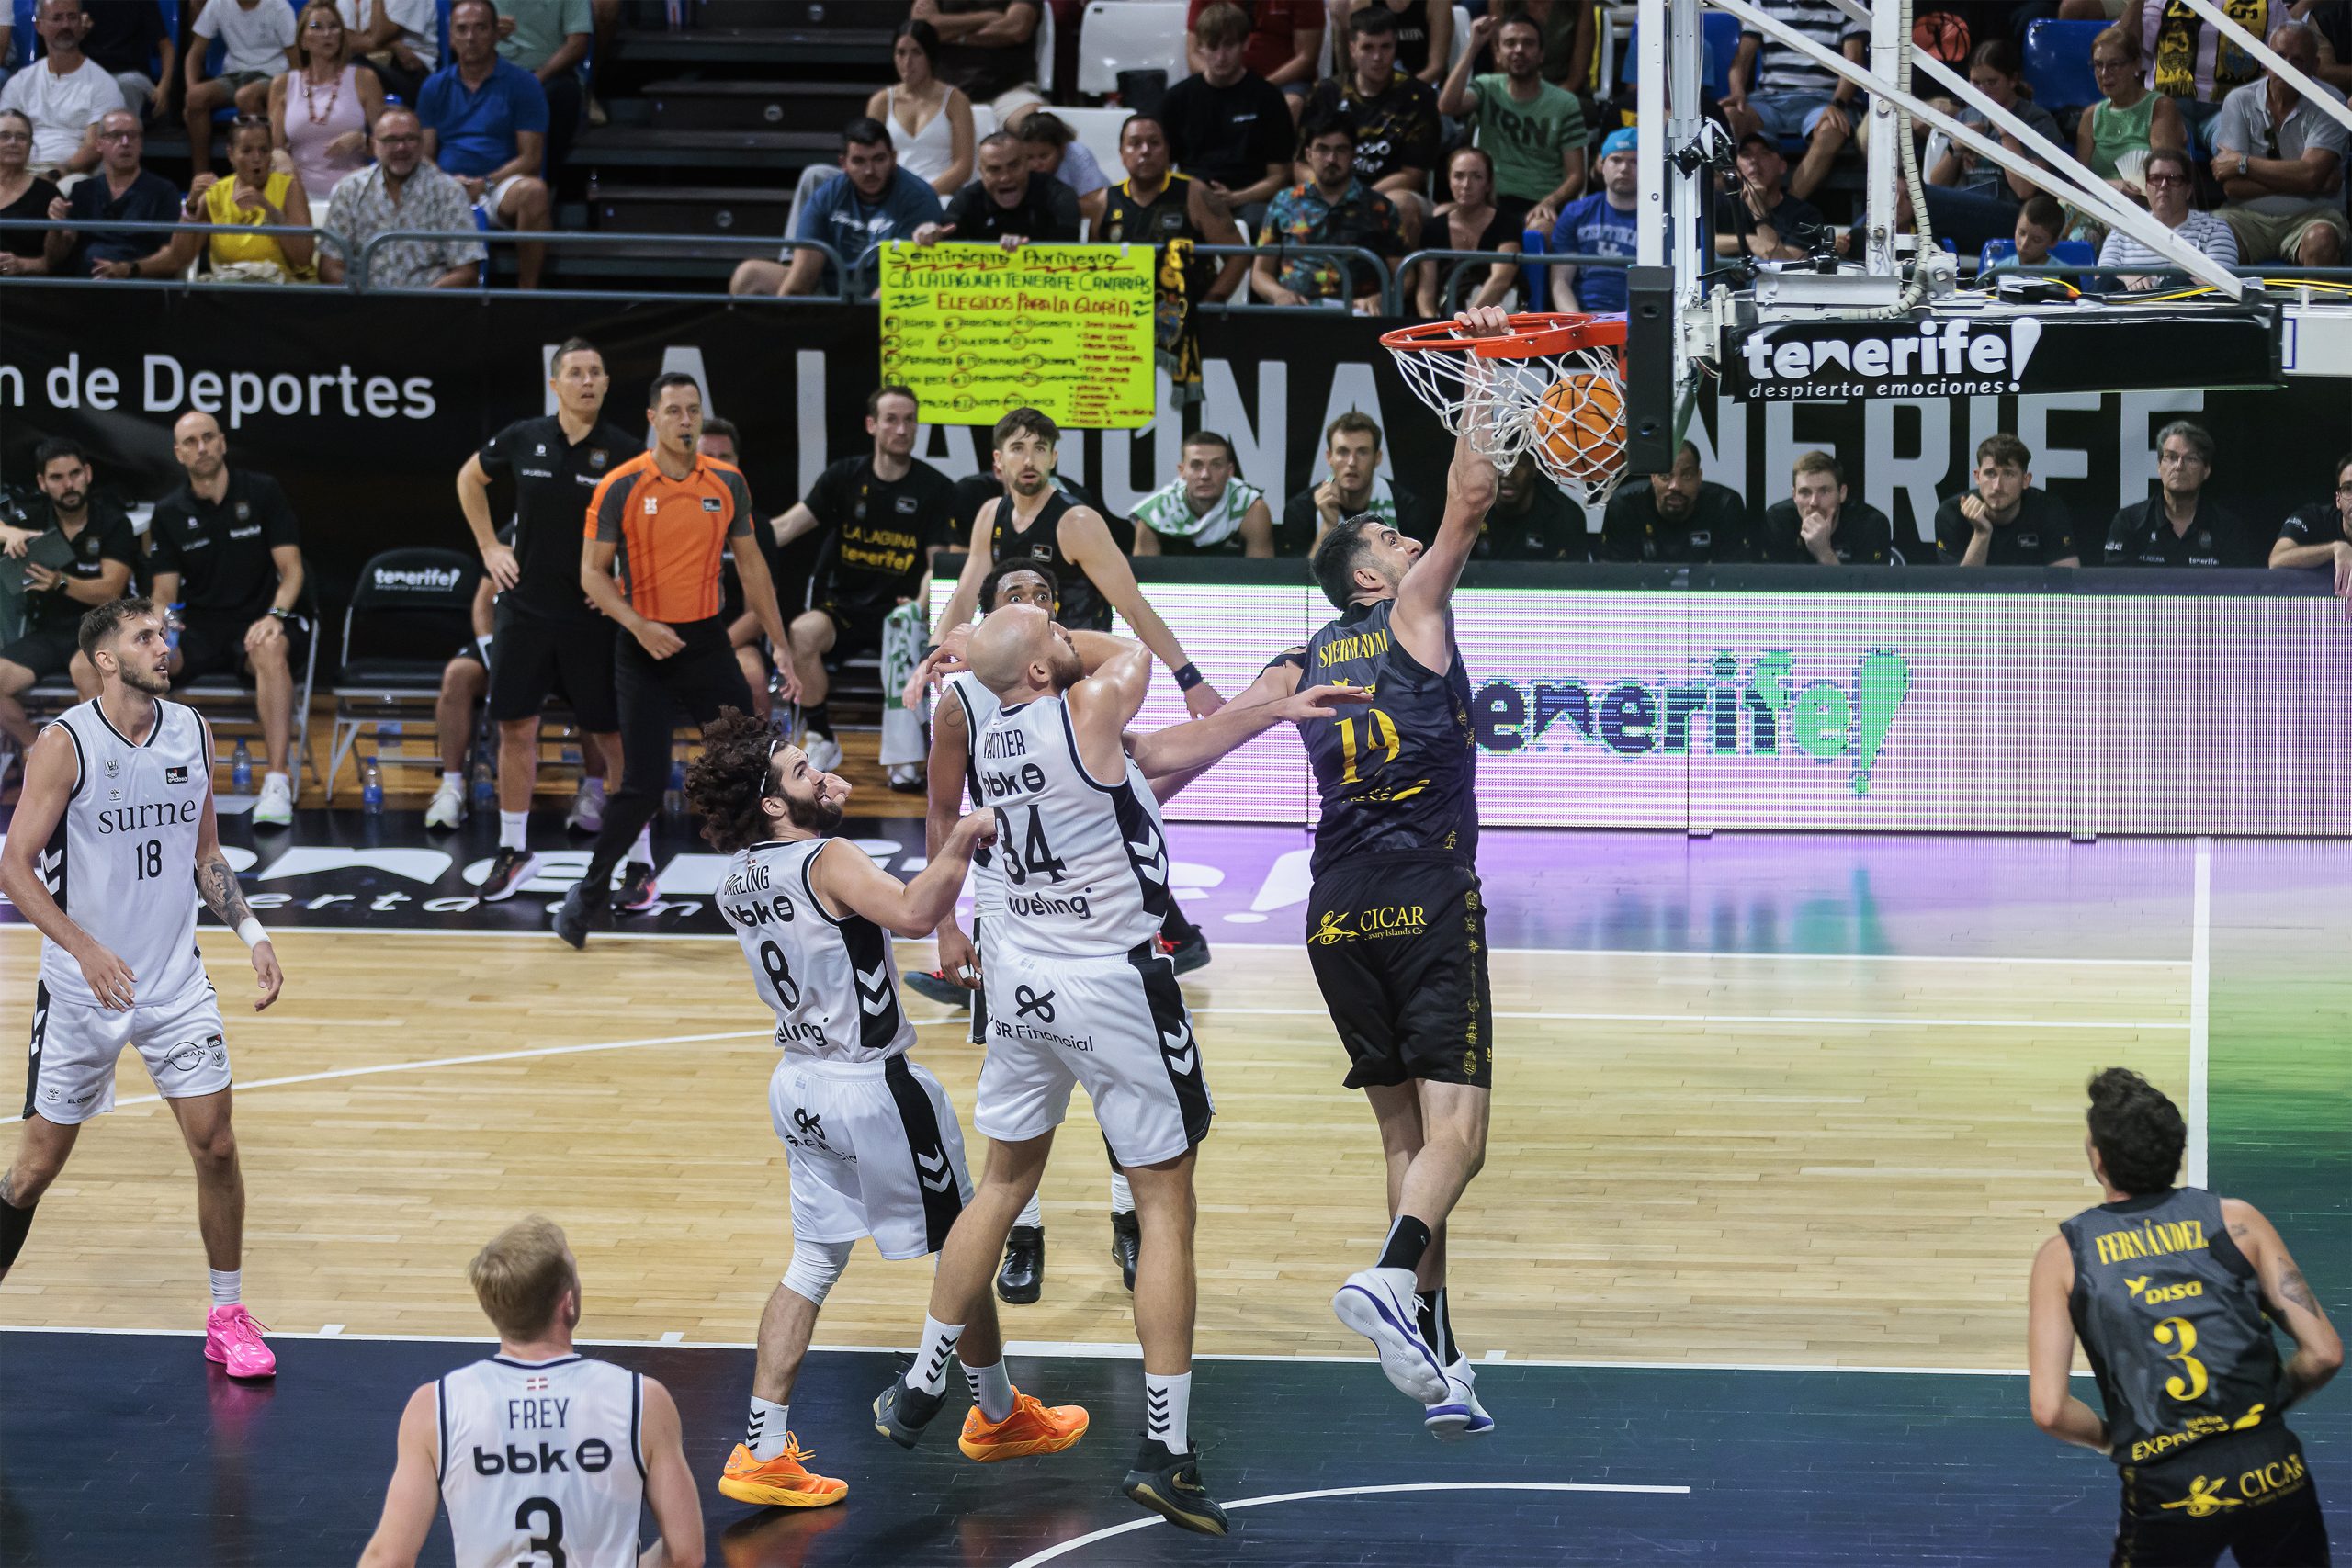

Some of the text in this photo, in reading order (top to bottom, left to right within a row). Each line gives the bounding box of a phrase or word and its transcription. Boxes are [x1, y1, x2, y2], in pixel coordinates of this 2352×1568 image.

[1742, 317, 2042, 392] tenerife!
[47, 352, 119, 410] de
[143, 353, 436, 429] Deportes
[1748, 380, 2004, 400] despierta emociones
[864, 529, 917, 549] LAGUNA
[375, 568, 461, 592] tenerife!
[1470, 648, 1911, 797] enerife!
[1335, 708, 1400, 786] 19
[98, 799, 196, 834] surne
[136, 839, 162, 880] 18
[993, 803, 1067, 886] 34
[1360, 906, 1427, 931] CICAR
[1385, 927, 1411, 937] Islands
[760, 940, 800, 1012] 8
[1016, 1024, 1094, 1053] Financial
[2095, 1219, 2209, 1265] FERNÁNDEZ
[2154, 1316, 2208, 1401] 3
[508, 1397, 570, 1430] FREY
[473, 1441, 570, 1476] bbk
[515, 1496, 567, 1568] 3
